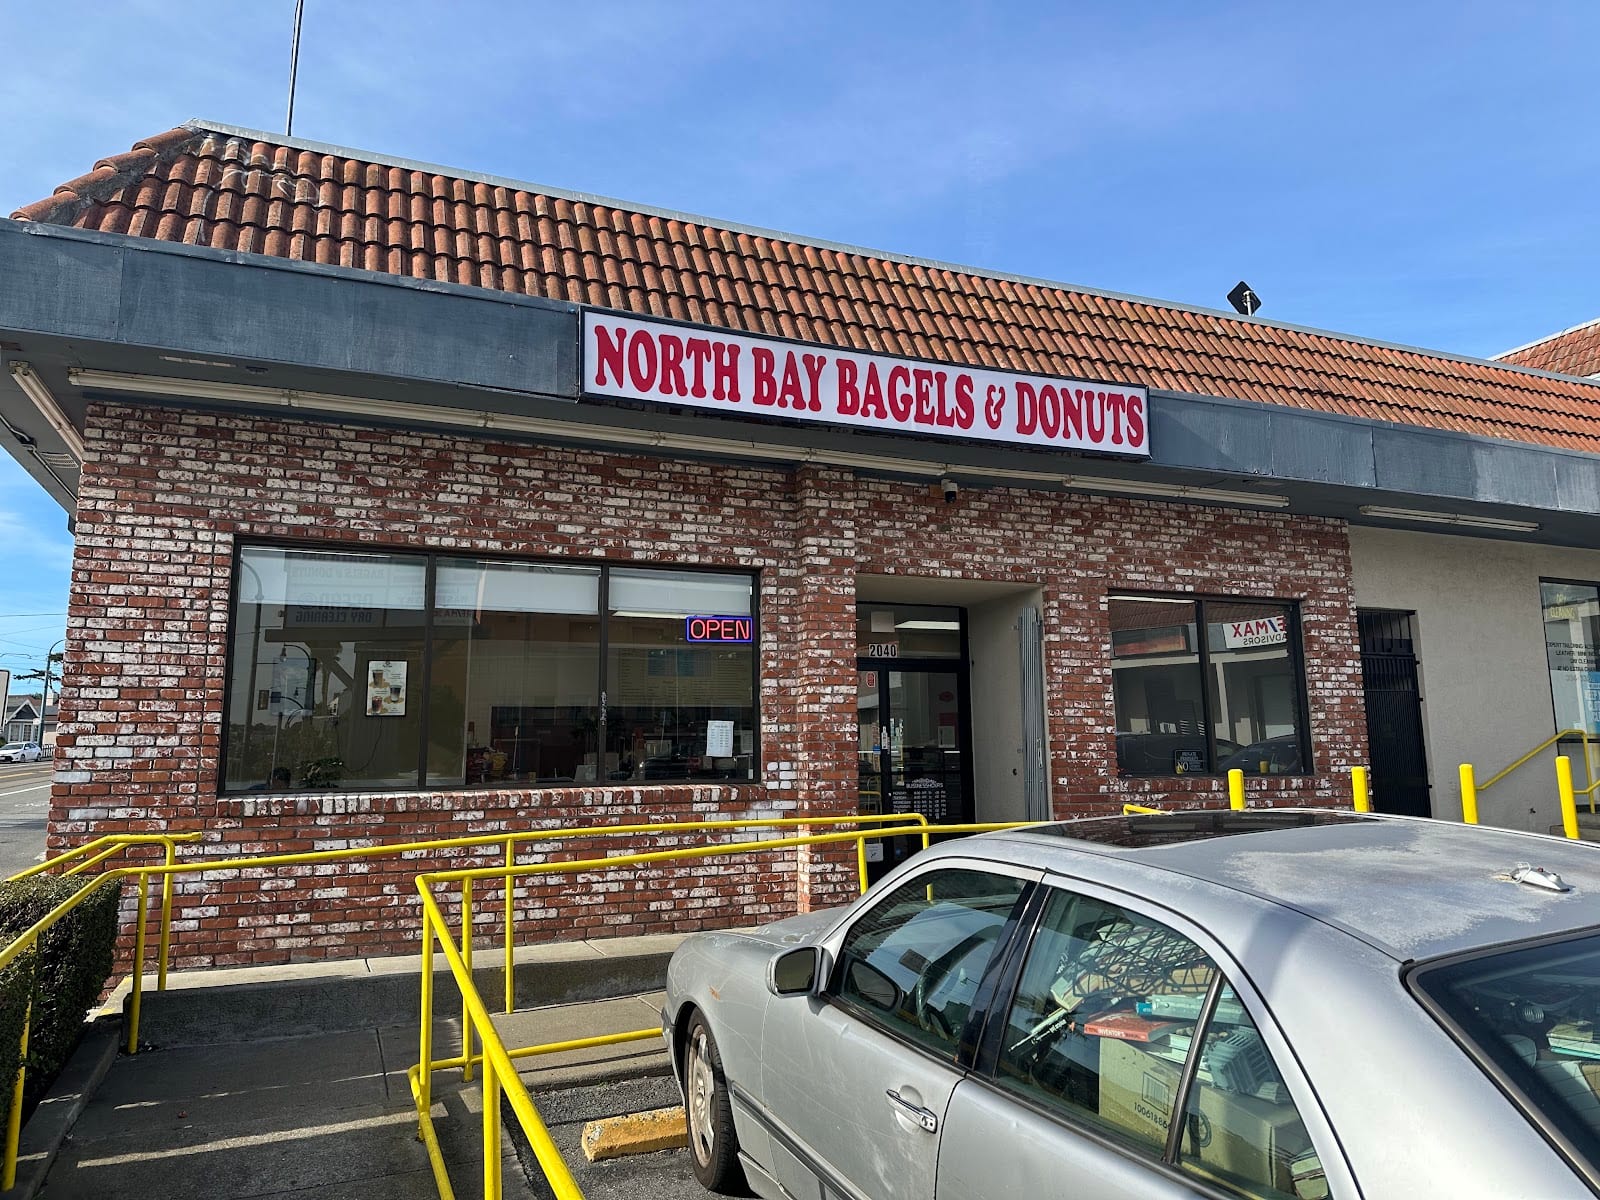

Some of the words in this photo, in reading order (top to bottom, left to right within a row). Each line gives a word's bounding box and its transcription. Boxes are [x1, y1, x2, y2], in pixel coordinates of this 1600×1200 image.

[594, 325, 741, 403] NORTH
[752, 347, 827, 412] BAY
[836, 359, 975, 430] BAGELS
[984, 384, 1006, 430] &
[1015, 382, 1144, 448] DONUTS
[690, 619, 750, 640] OPEN
[869, 644, 897, 657] 2040
[1176, 761, 1188, 772] NO
